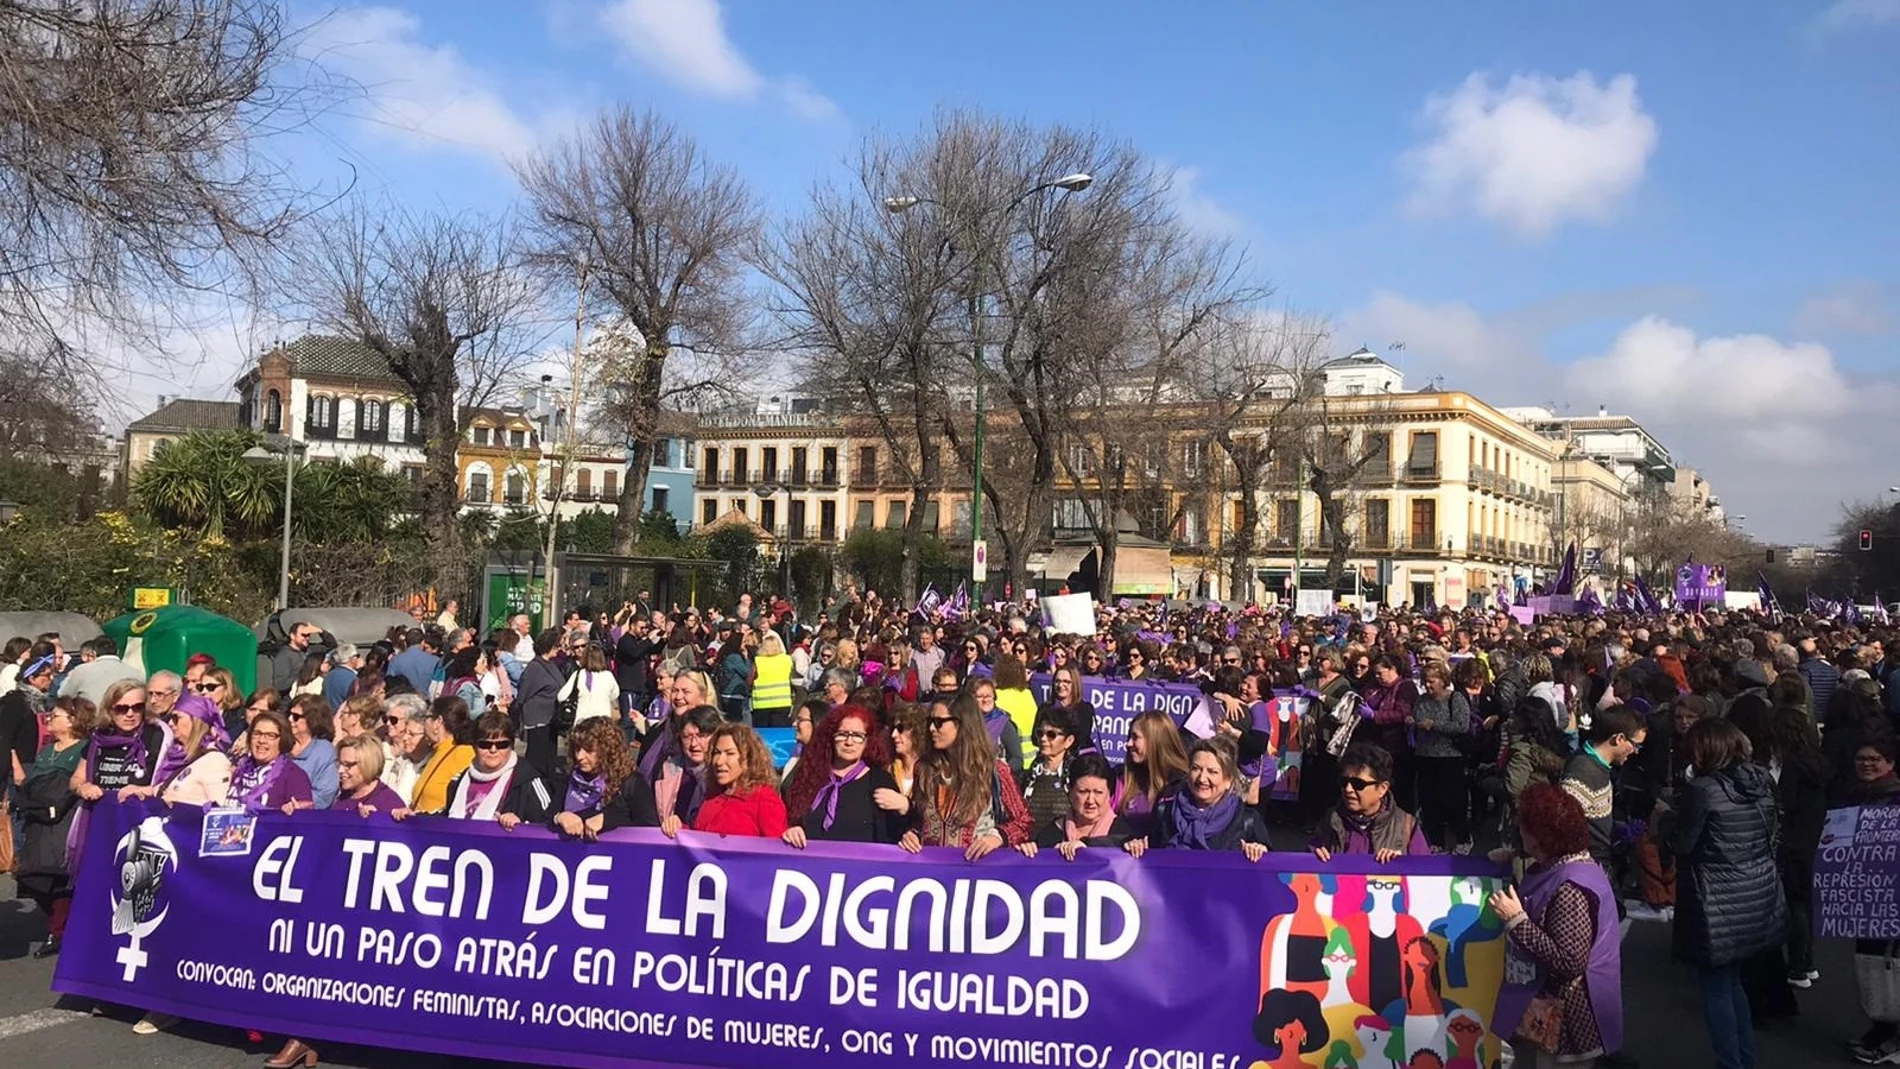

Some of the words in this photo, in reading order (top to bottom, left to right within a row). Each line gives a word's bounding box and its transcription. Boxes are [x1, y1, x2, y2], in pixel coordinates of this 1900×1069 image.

[1091, 689, 1115, 709] DE
[1123, 691, 1145, 711] LA
[1154, 694, 1192, 715] DIGN
[99, 762, 141, 772] LIBERAD
[100, 776, 129, 784] TIENE
[1861, 820, 1878, 829] DE
[1880, 819, 1898, 829] LA
[1823, 845, 1897, 862] CONTRA
[1843, 861, 1863, 875] LA
[252, 835, 304, 903] EL
[342, 838, 494, 920] TREN
[522, 852, 613, 930] DE
[645, 858, 728, 939] LA
[766, 868, 1141, 961] DIGNIDAD
[1821, 888, 1895, 903] FASCISTA
[1822, 902, 1864, 916] HACIA
[1871, 903, 1899, 918] LAS
[1821, 917, 1900, 938] MUJERES
[269, 918, 294, 954] NI
[306, 921, 345, 960] UN
[357, 926, 442, 969] PASO
[454, 931, 558, 980] ATRÁS
[573, 946, 616, 986] EN
[632, 946, 811, 1002] POLÍTICAS
[829, 966, 878, 1007] DE
[897, 969, 1089, 1019] IGUALDAD
[177, 959, 256, 990] CONVOCAN:
[262, 972, 406, 1008] ORGANIZACIONES
[413, 989, 525, 1025] FEMINISTAS,
[531, 1001, 677, 1036] ASOCIACIONES
[687, 1016, 713, 1041] DE
[724, 1020, 830, 1053] MUJERES,
[841, 1029, 893, 1055] ONG
[904, 1033, 919, 1057] Y
[931, 1035, 1112, 1069] MOVIMIENTOS
[1124, 1047, 1240, 1069] SOCIALES
